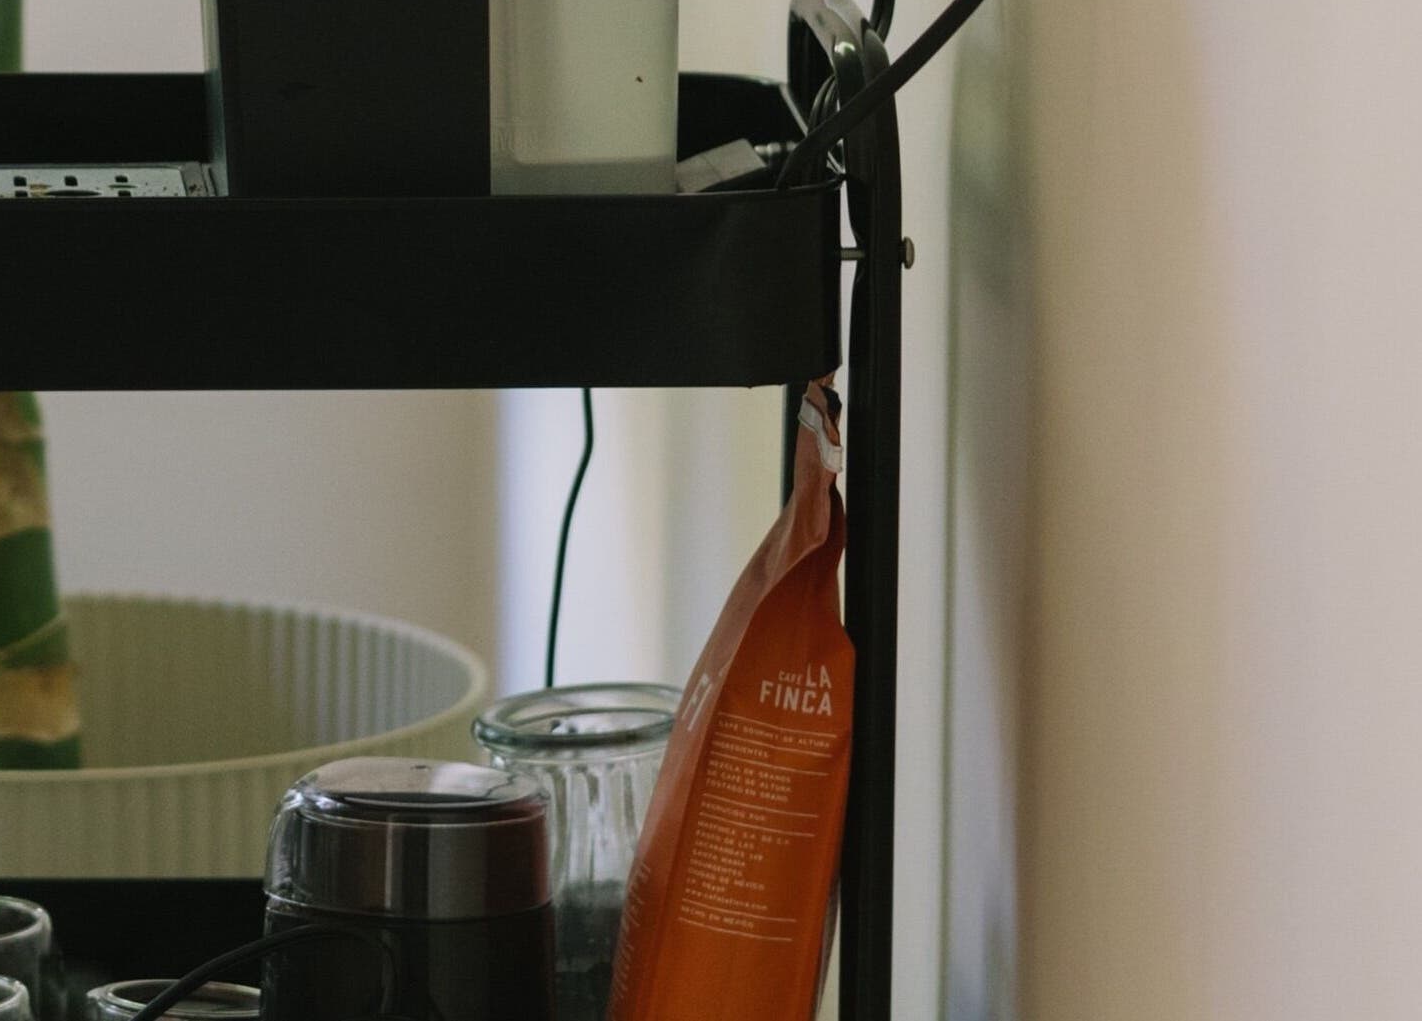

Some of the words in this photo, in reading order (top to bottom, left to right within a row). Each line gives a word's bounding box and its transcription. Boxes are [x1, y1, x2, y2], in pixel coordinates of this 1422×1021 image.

[805, 662, 832, 690] LA
[759, 679, 832, 717] FINCA
[797, 737, 831, 749] ALTURA
